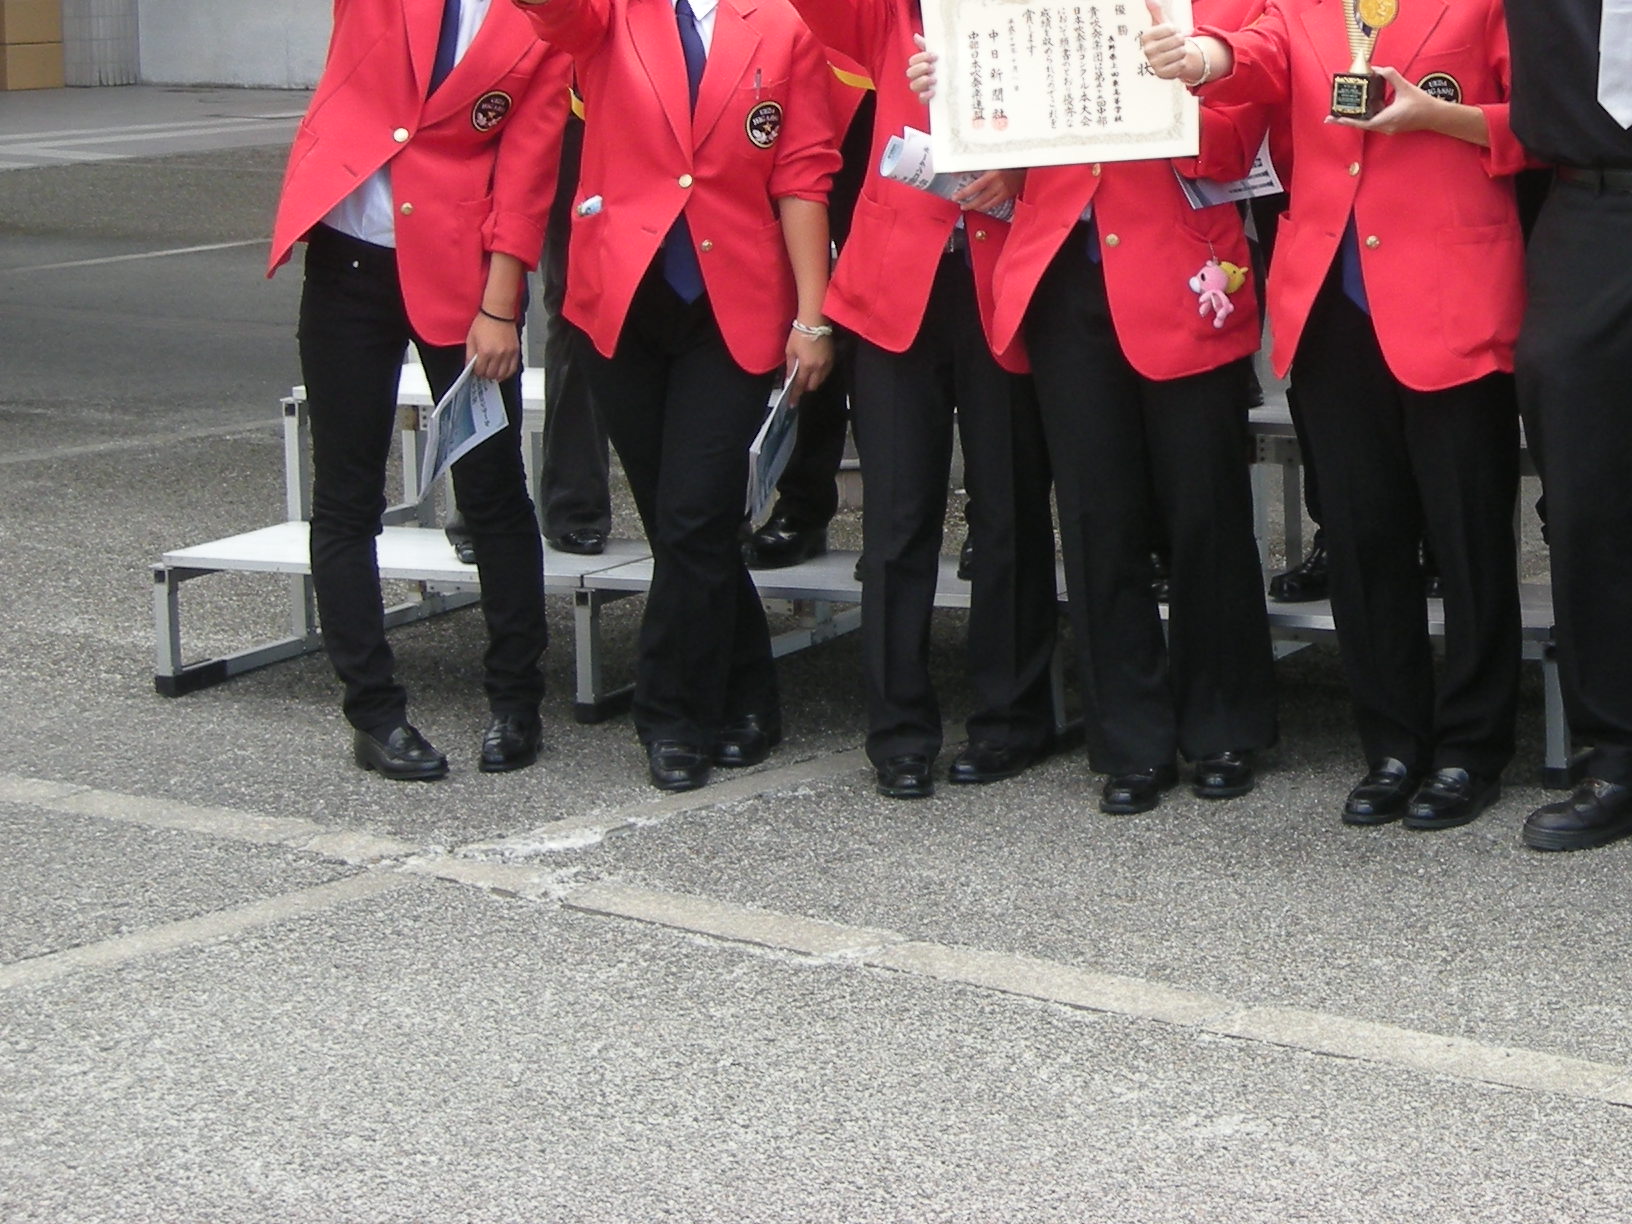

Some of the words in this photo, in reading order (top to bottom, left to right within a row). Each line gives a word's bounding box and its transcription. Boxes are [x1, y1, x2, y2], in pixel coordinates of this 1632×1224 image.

[988, 29, 1008, 120] 中日新聞社
